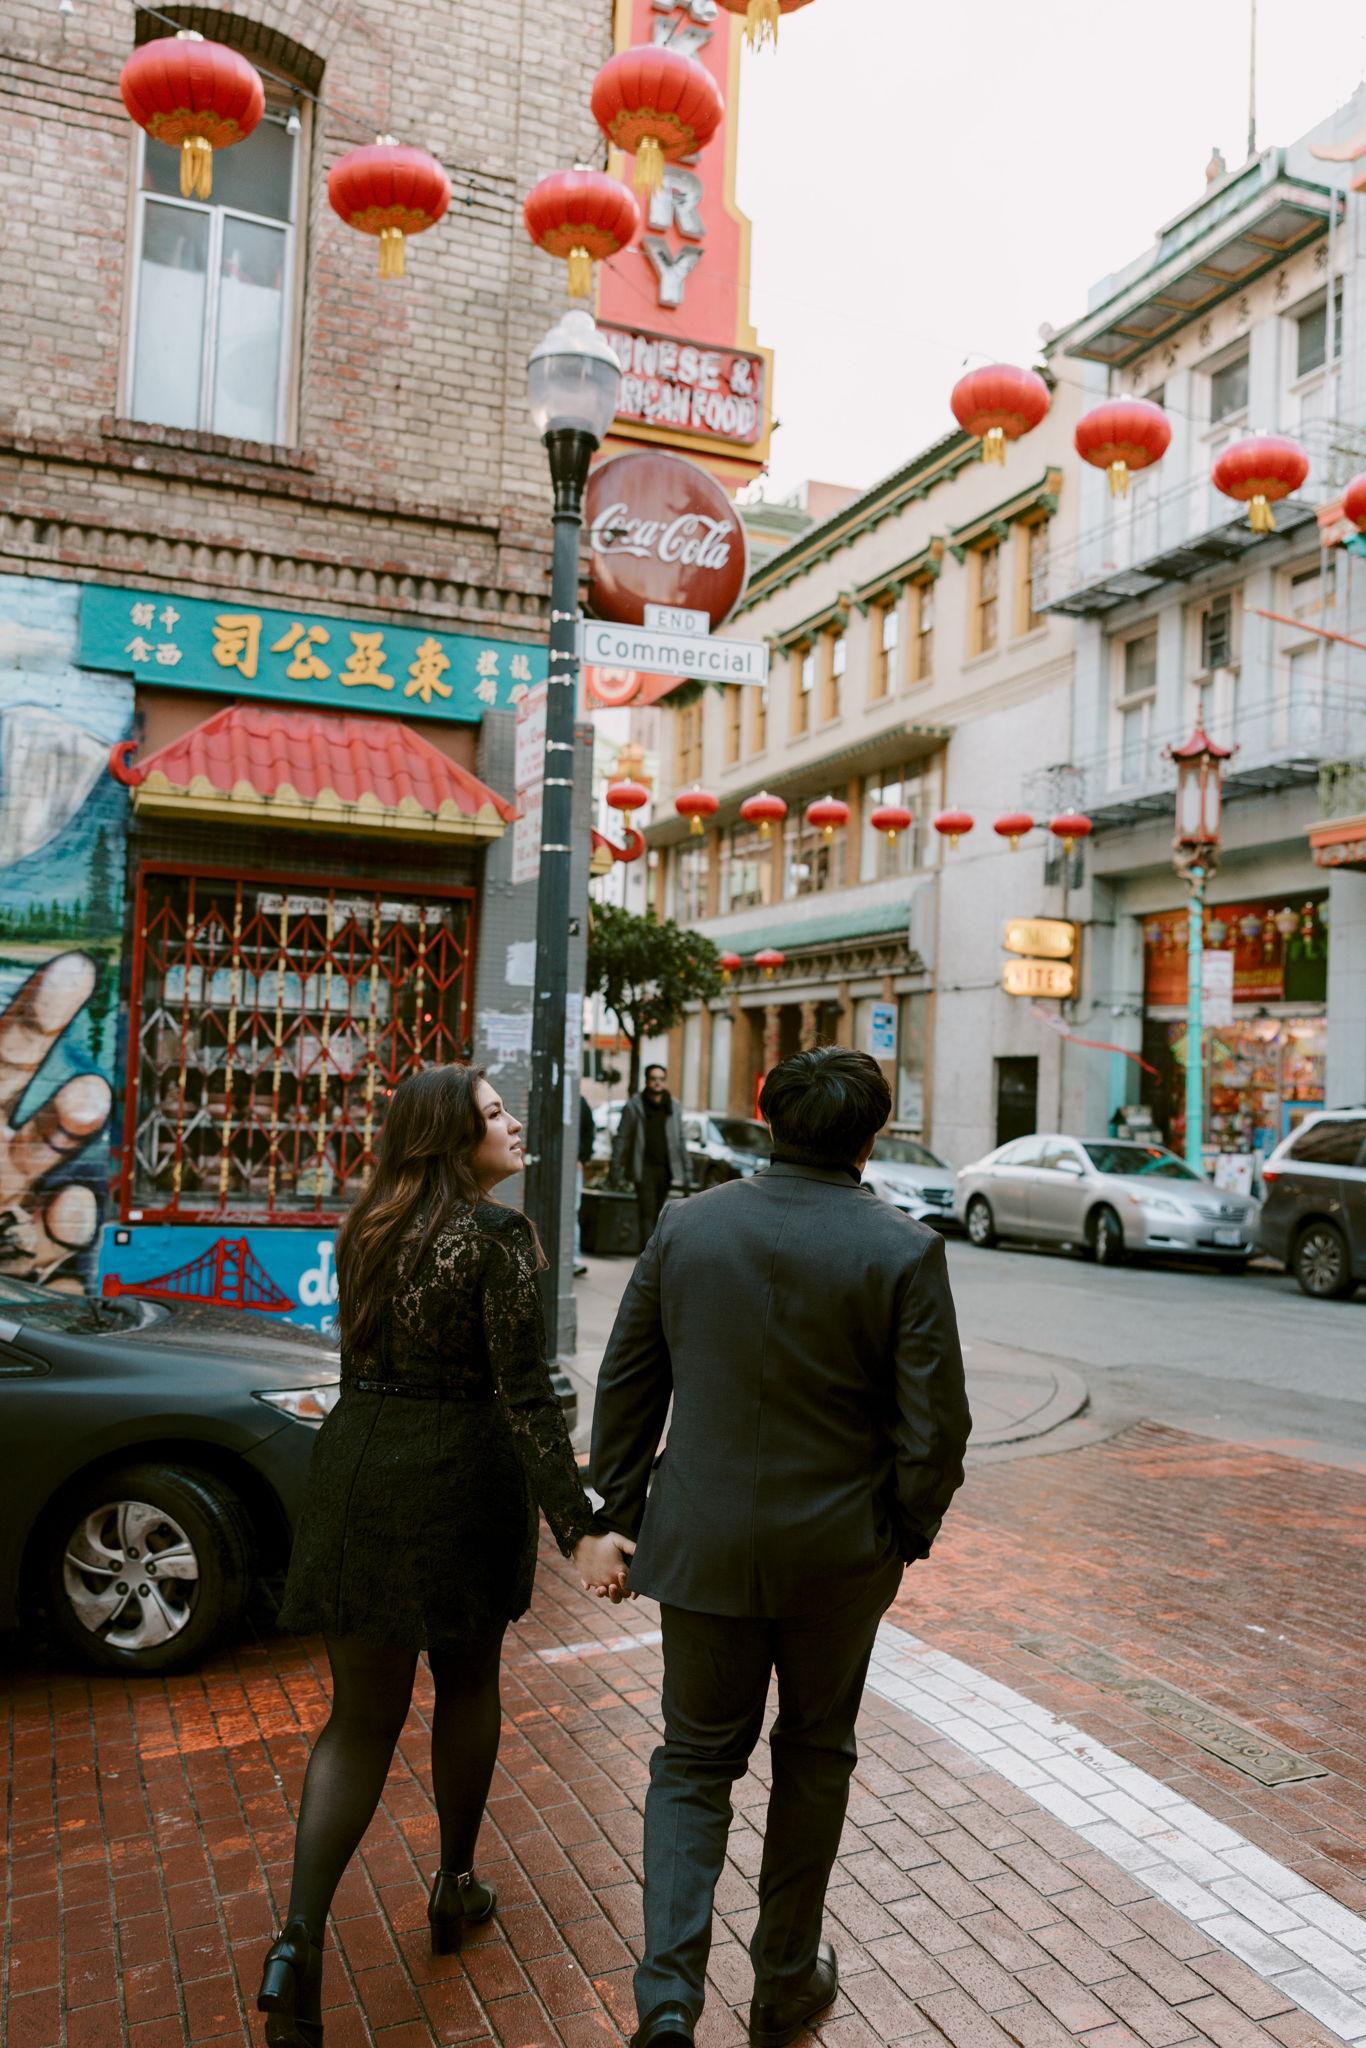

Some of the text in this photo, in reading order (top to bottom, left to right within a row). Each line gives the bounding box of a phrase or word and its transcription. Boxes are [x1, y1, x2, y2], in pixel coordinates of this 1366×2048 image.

[729, 358, 753, 395] &
[691, 388, 757, 436] FOOD
[590, 502, 735, 570] Coca-Cola
[657, 610, 696, 631] END
[596, 632, 752, 673] Commercial
